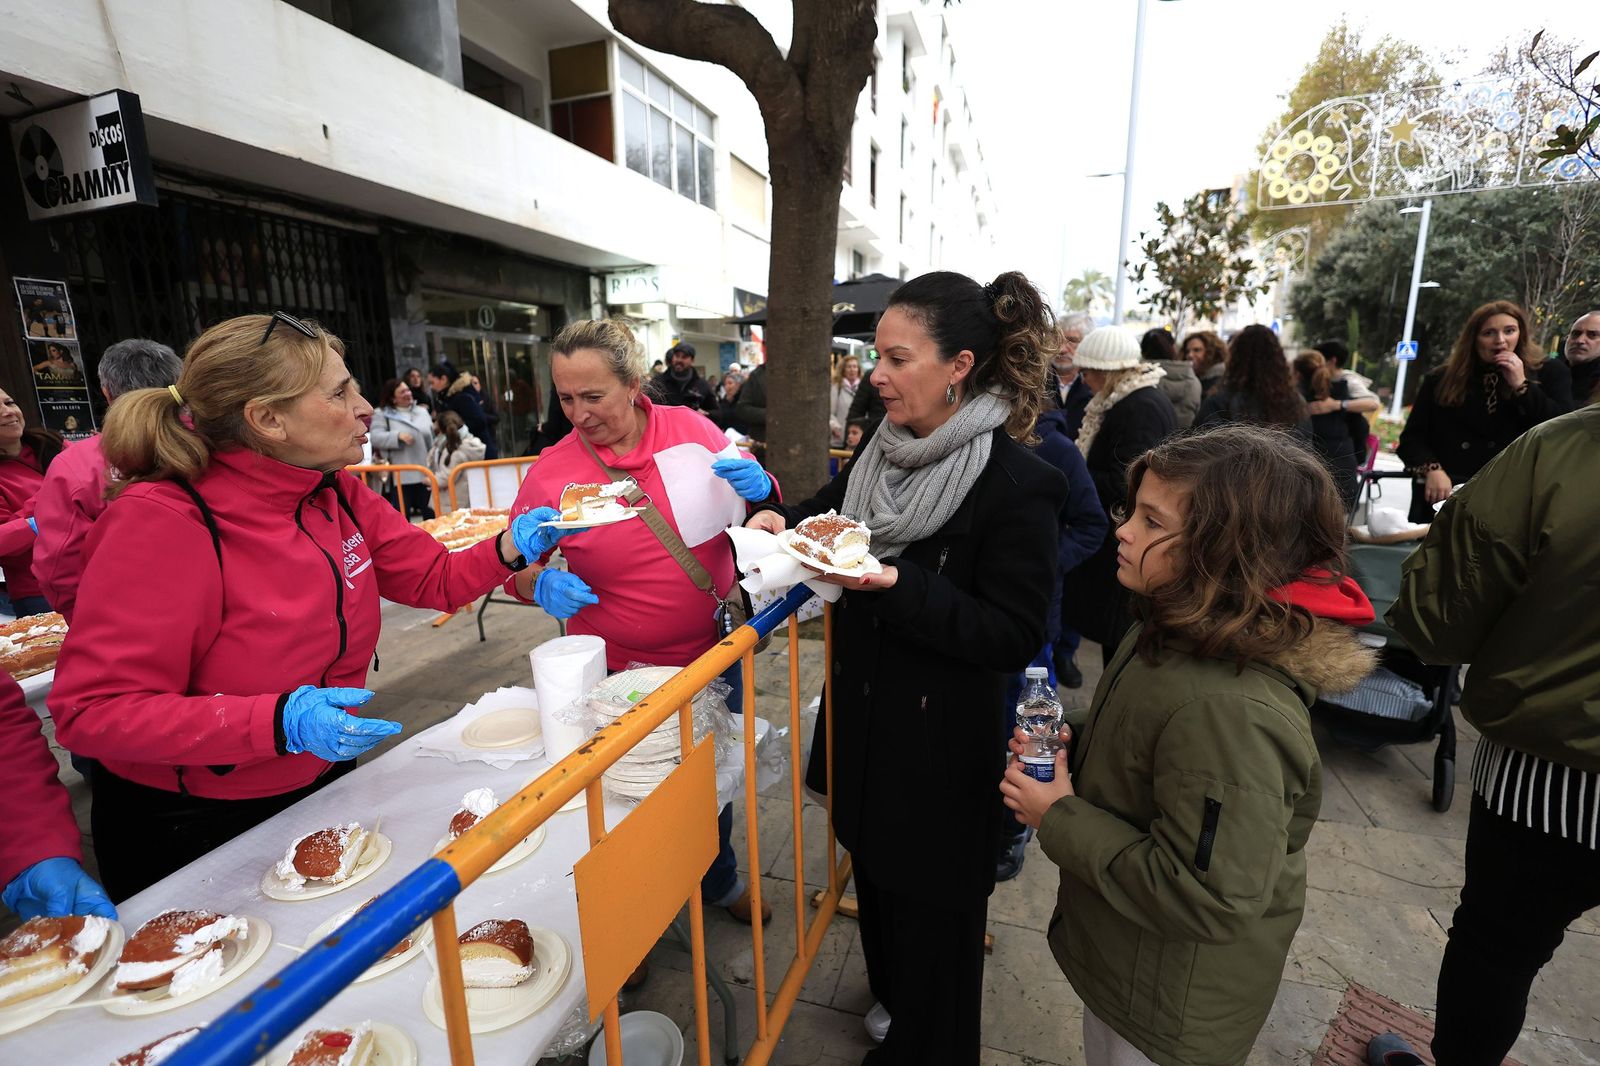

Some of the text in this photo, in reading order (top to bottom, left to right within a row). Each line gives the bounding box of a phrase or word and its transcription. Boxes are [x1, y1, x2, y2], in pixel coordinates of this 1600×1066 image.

[89, 123, 122, 148] DISCOS
[46, 161, 130, 207] GRAMMY
[342, 532, 364, 555] dera
